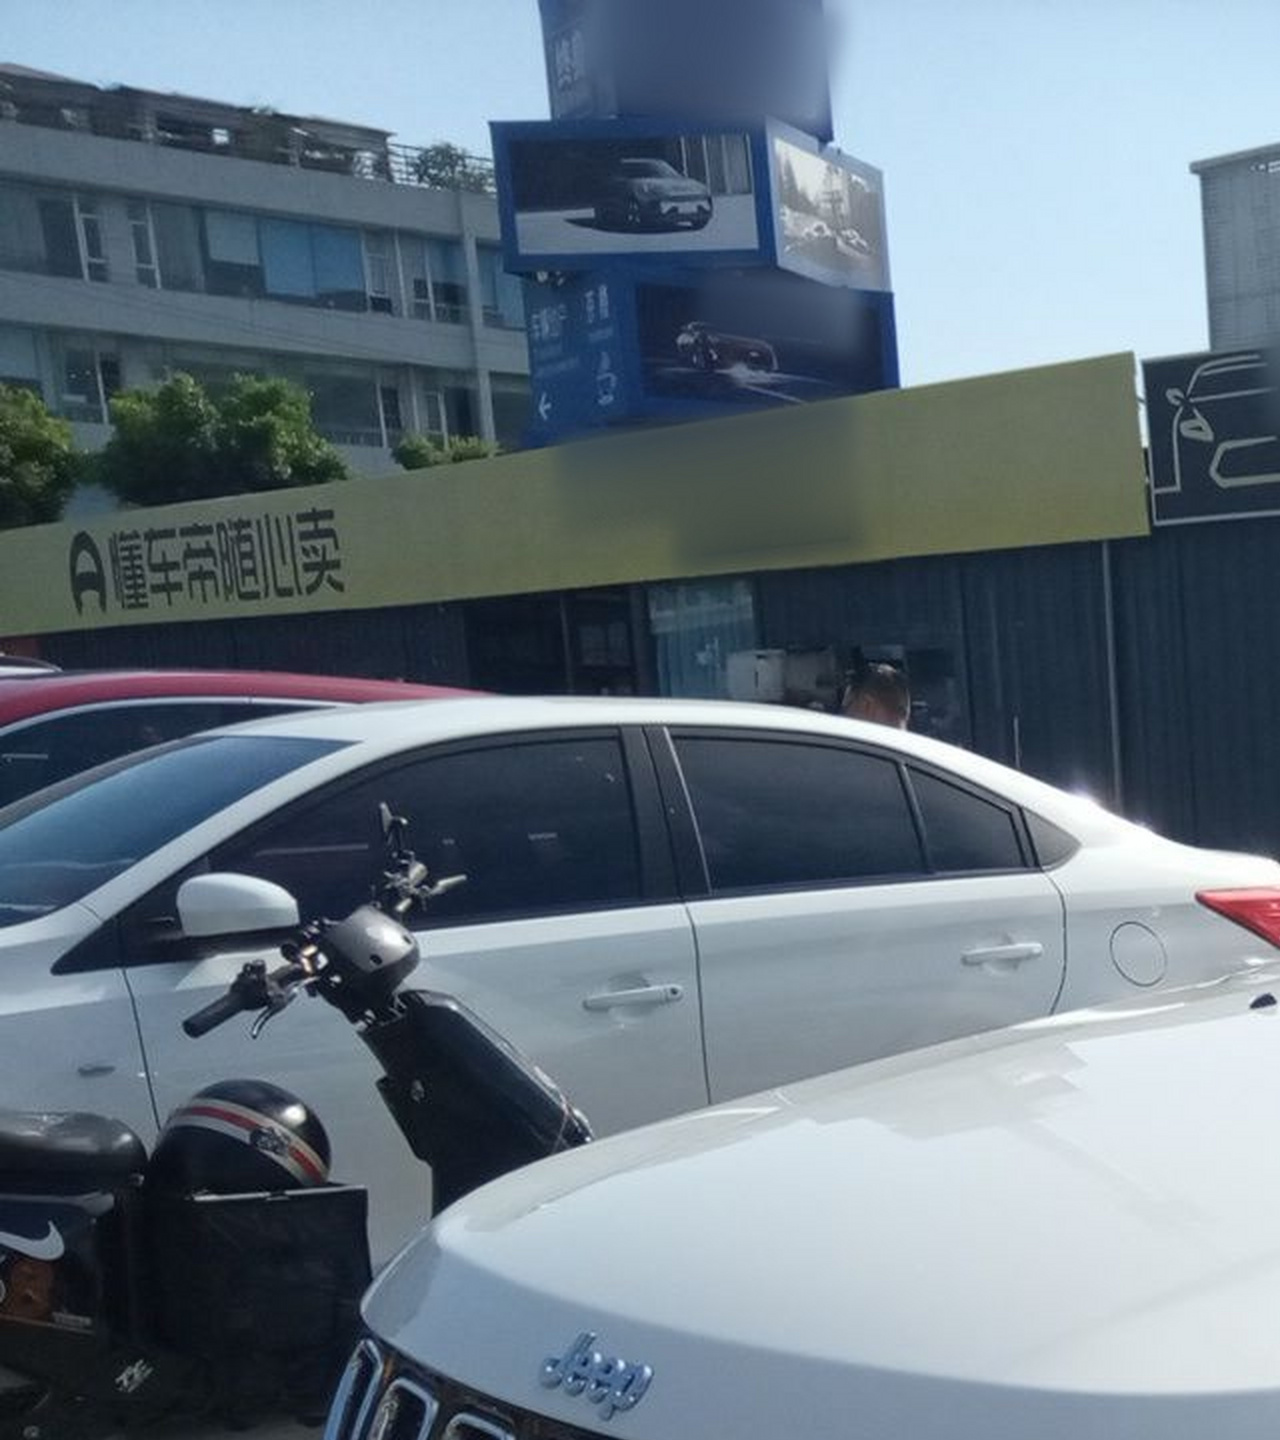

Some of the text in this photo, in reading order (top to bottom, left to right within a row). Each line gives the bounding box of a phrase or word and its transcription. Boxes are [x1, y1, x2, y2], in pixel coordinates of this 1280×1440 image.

[109, 507, 345, 609] 懂车帝随心卖
[540, 1331, 654, 1421] Jeep
